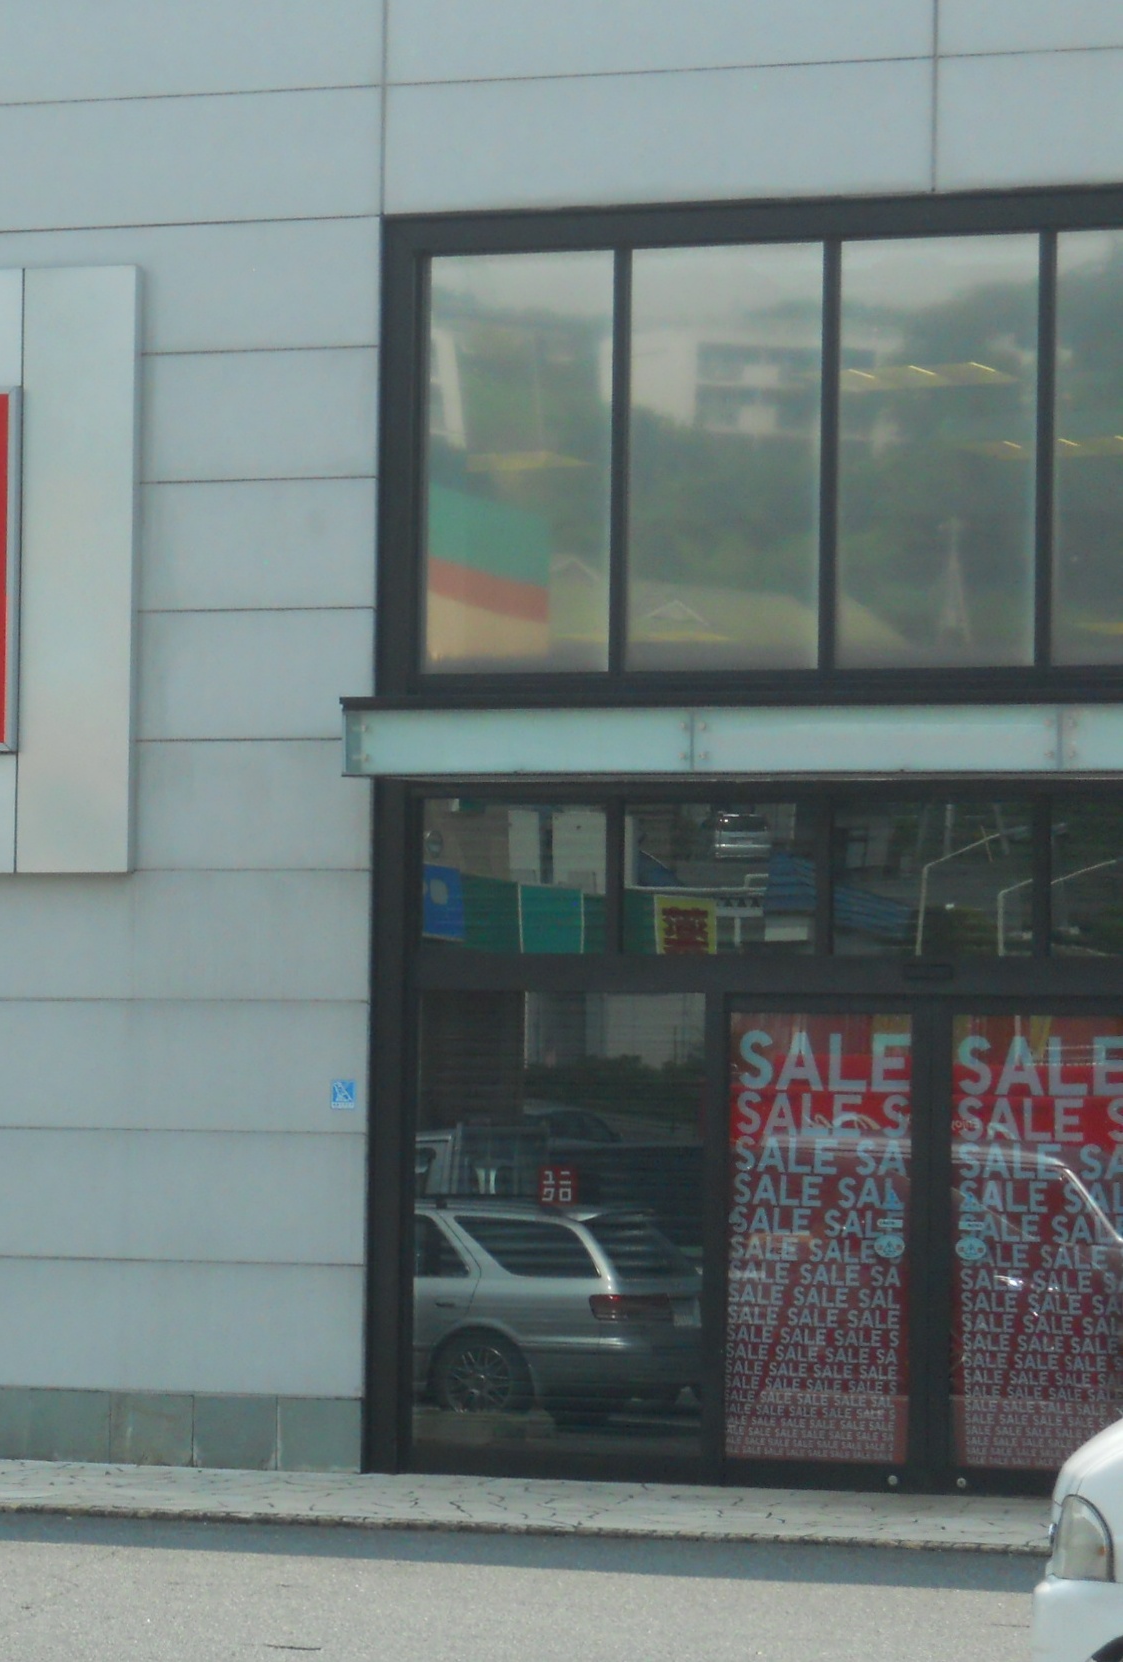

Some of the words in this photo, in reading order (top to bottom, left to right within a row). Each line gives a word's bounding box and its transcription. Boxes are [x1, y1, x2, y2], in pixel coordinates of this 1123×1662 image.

[739, 1030, 911, 1092] SALE
[958, 1036, 1123, 1096] SALE
[737, 1091, 862, 1137] SALE
[958, 1097, 1084, 1142] SALE
[735, 1135, 839, 1174] SALE
[856, 1138, 907, 1177] SA
[959, 1142, 1061, 1179] SALE
[543, 1171, 571, 1184] ユニ
[542, 1188, 571, 1201] クロ
[734, 1172, 823, 1206] SALE
[732, 1205, 811, 1235] SALE
[731, 1235, 799, 1260] SALE
[809, 1239, 877, 1264] SALE
[1040, 1246, 1108, 1269] SALE
[730, 1261, 790, 1283] SALE
[800, 1264, 860, 1286] SALE
[871, 1267, 901, 1289] SA
[728, 1284, 783, 1304] SALE
[793, 1286, 848, 1307] SALE
[859, 1289, 900, 1310] SAL
[961, 1292, 1018, 1312] SALE
[1028, 1294, 1081, 1314] SALE
[728, 1307, 778, 1326] SALE
[787, 1308, 839, 1328] SALE
[847, 1310, 900, 1329] SALE
[961, 1314, 1015, 1332] SALE
[1022, 1316, 1073, 1334] SALE
[727, 1325, 773, 1343] SALE
[780, 1327, 827, 1345] SALE
[834, 1329, 881, 1347] SALE
[962, 1334, 1010, 1351] SALE
[1017, 1335, 1064, 1352] SALE
[726, 1343, 768, 1359] SALE
[775, 1345, 818, 1361] SALE
[825, 1347, 869, 1363] SALE
[877, 1349, 897, 1365] SA
[963, 1352, 1008, 1368] SALE
[1014, 1354, 1059, 1369] SALE
[1065, 1356, 1108, 1371] SALE
[769, 1362, 808, 1376] SALE
[813, 1363, 853, 1378] SALE
[859, 1365, 898, 1379] SALE
[963, 1370, 1004, 1384] SALE
[1009, 1371, 1048, 1385] SALE
[1055, 1372, 1091, 1386] SALE
[765, 1377, 800, 1390] SALE
[806, 1378, 842, 1392] SALE
[848, 1380, 883, 1393] SALE
[964, 1386, 1000, 1399] SALE
[1007, 1387, 1042, 1400] SALE
[1048, 1388, 1084, 1401] SALE
[760, 1391, 793, 1403] SALE
[797, 1393, 828, 1405] SALE
[834, 1394, 867, 1406] SALE
[965, 1400, 997, 1411] SALE
[1002, 1402, 1035, 1412] SALE
[1040, 1403, 1072, 1414] SALE
[756, 1404, 784, 1416] SALE
[789, 1406, 818, 1417] SALE
[822, 1408, 851, 1418] SALE
[965, 1413, 994, 1424] SALE
[999, 1414, 1028, 1425] SALE
[1032, 1415, 1062, 1426] SALE
